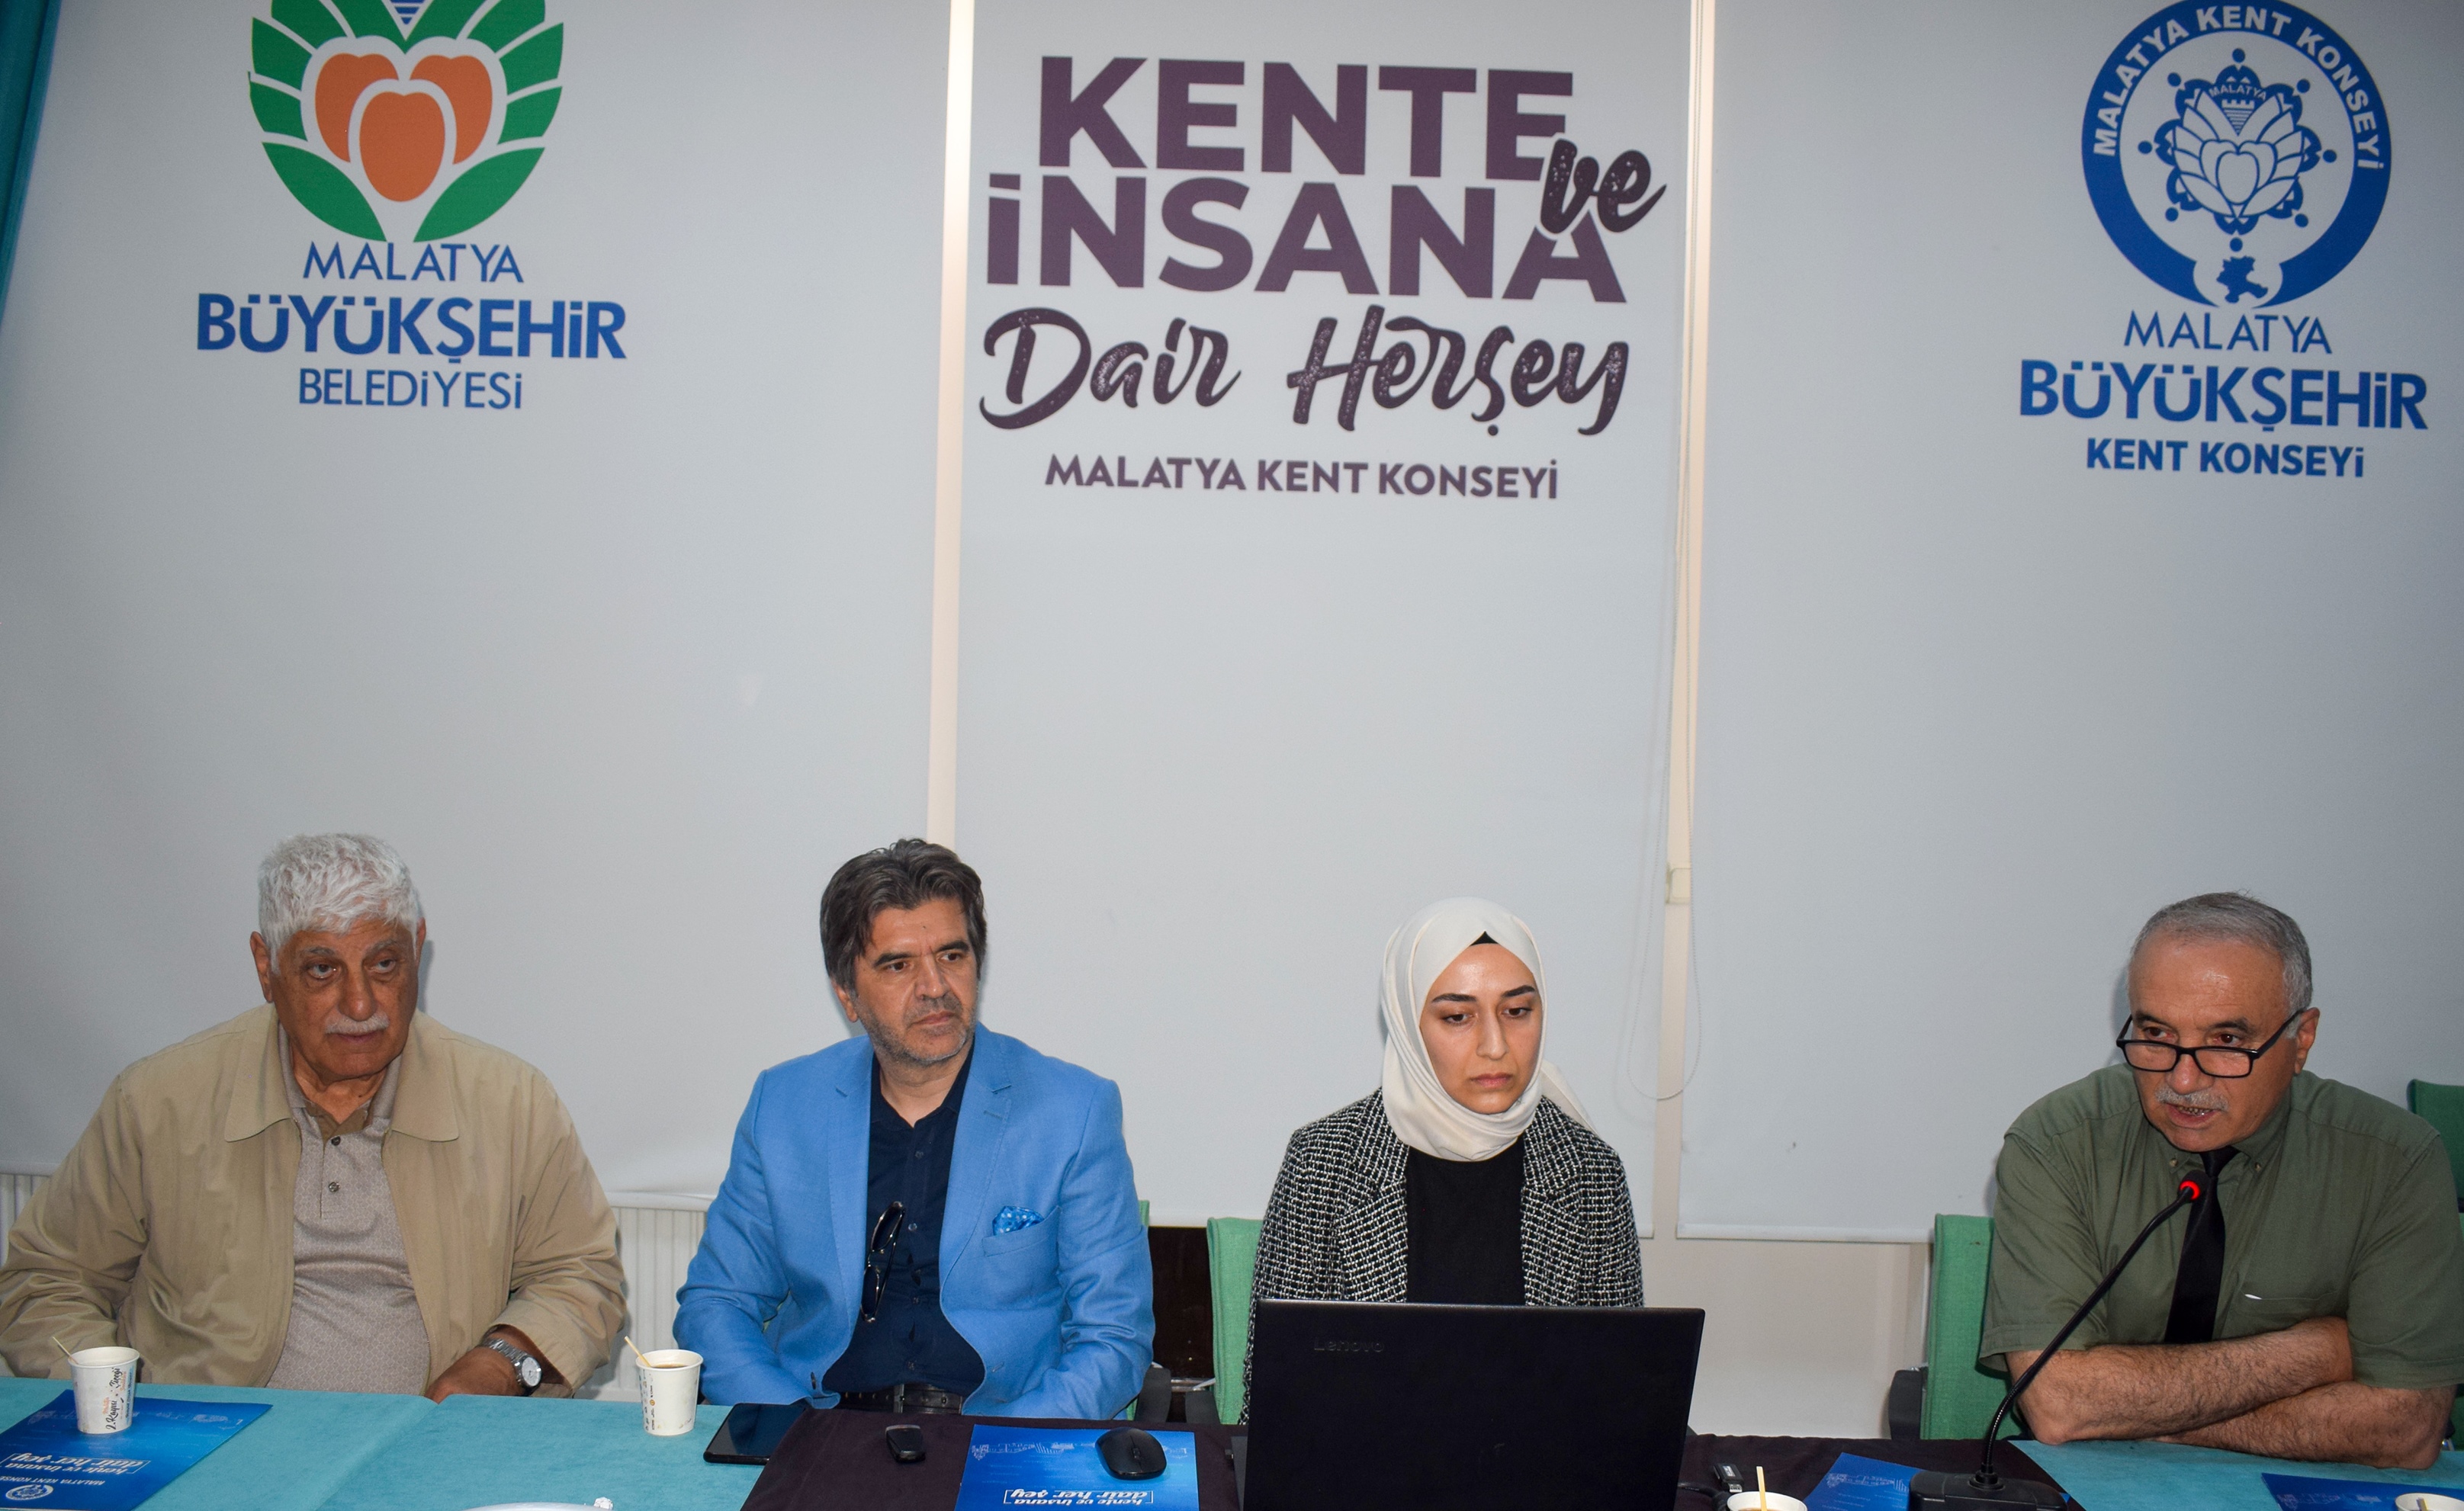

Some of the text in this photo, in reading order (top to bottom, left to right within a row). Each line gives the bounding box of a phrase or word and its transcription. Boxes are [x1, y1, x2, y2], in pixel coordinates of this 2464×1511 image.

[2093, 18, 2191, 157] MALATYA
[2196, 5, 2292, 35] KENT
[2209, 84, 2267, 101] MALATYA
[1038, 56, 1574, 182] KENTE
[1539, 138, 1668, 234] ve
[302, 241, 525, 283] MALATYA
[2123, 310, 2333, 354] MALATYA
[978, 304, 1630, 437] Dair Herşey
[2086, 437, 2189, 473] KENT
[1044, 454, 1247, 490] MALATYA
[1257, 458, 1369, 495] KENT
[1313, 1336, 1385, 1353] Lenovo
[50, 1457, 92, 1467] her
[92, 1458, 143, 1468] dair
[1052, 1491, 1093, 1500] her
[1096, 1491, 1148, 1500] dair
